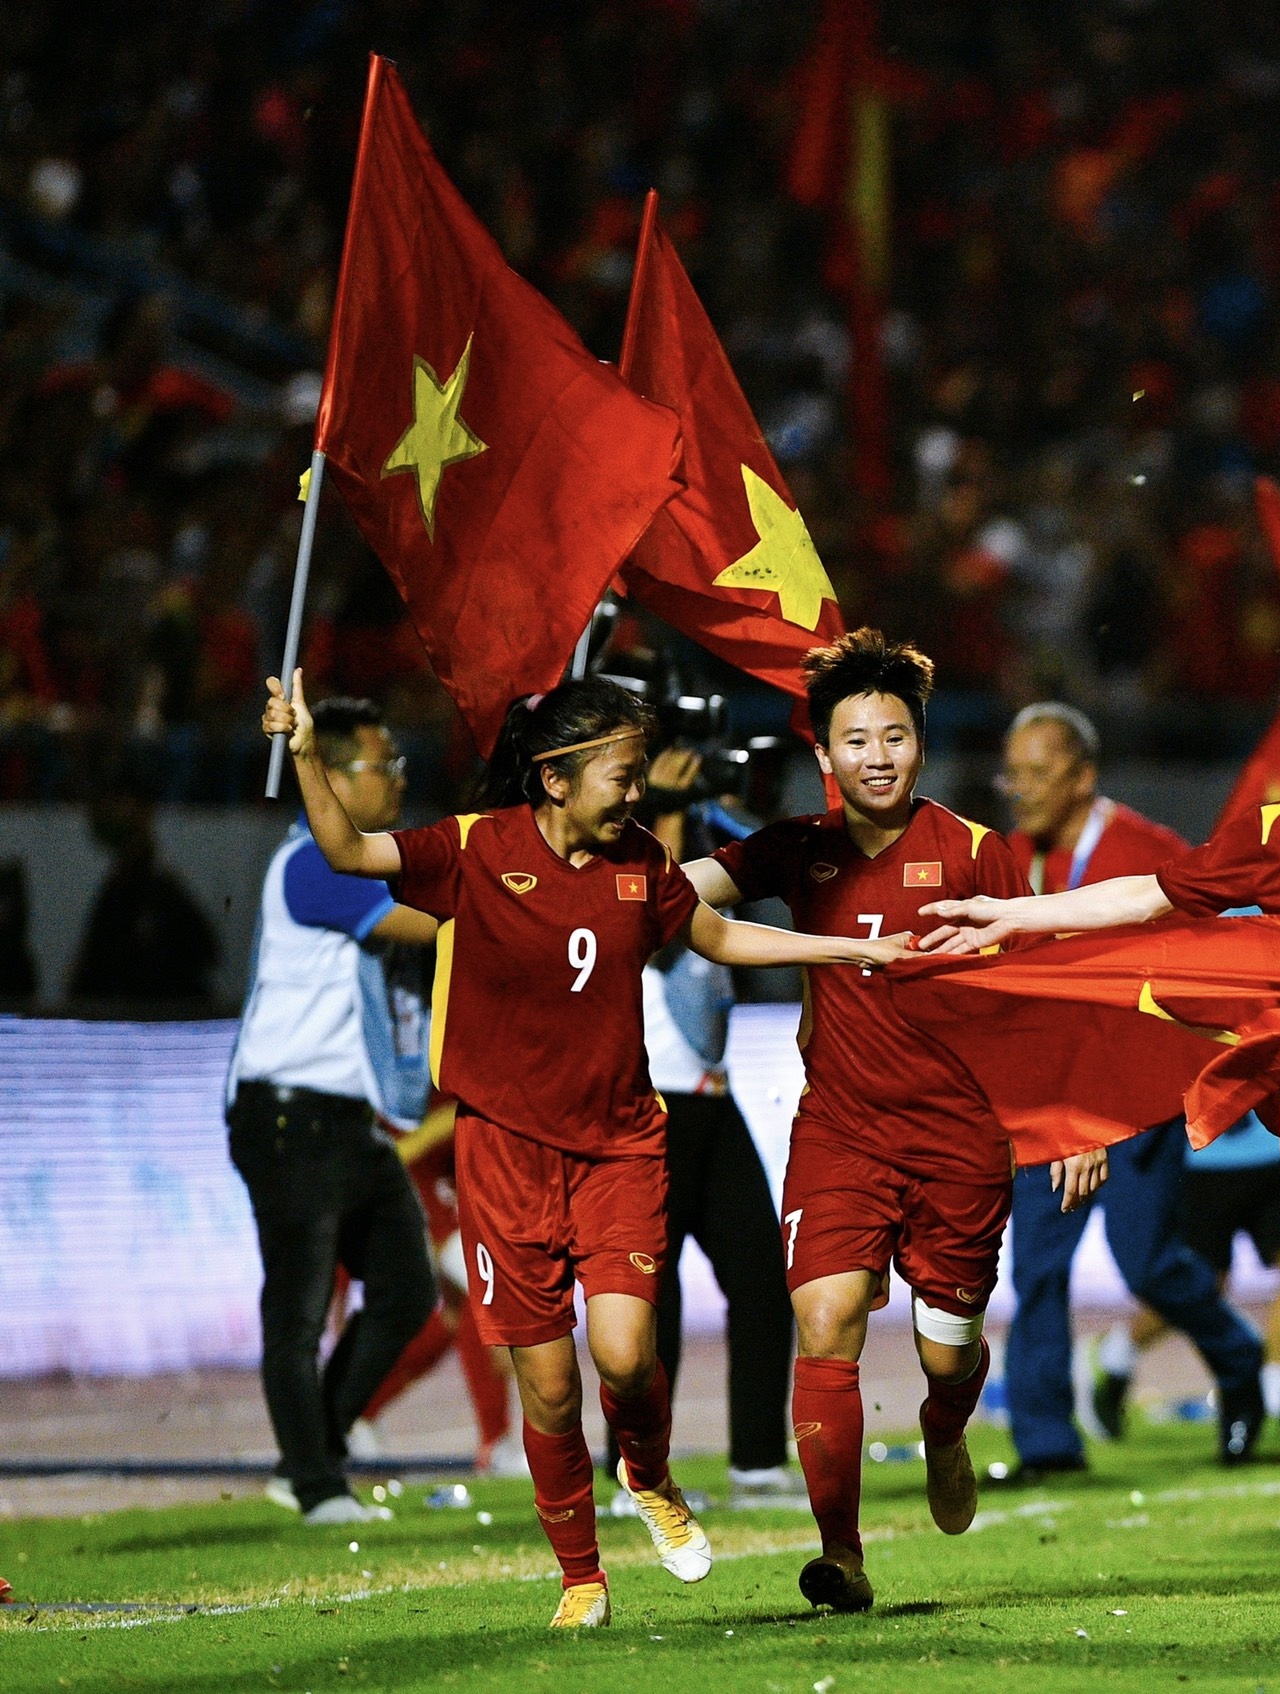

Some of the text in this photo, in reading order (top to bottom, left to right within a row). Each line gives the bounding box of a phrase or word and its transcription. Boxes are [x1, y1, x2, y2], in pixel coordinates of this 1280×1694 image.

[567, 927, 597, 993] 9
[857, 913, 884, 977] 7
[476, 1242, 494, 1305] 9
